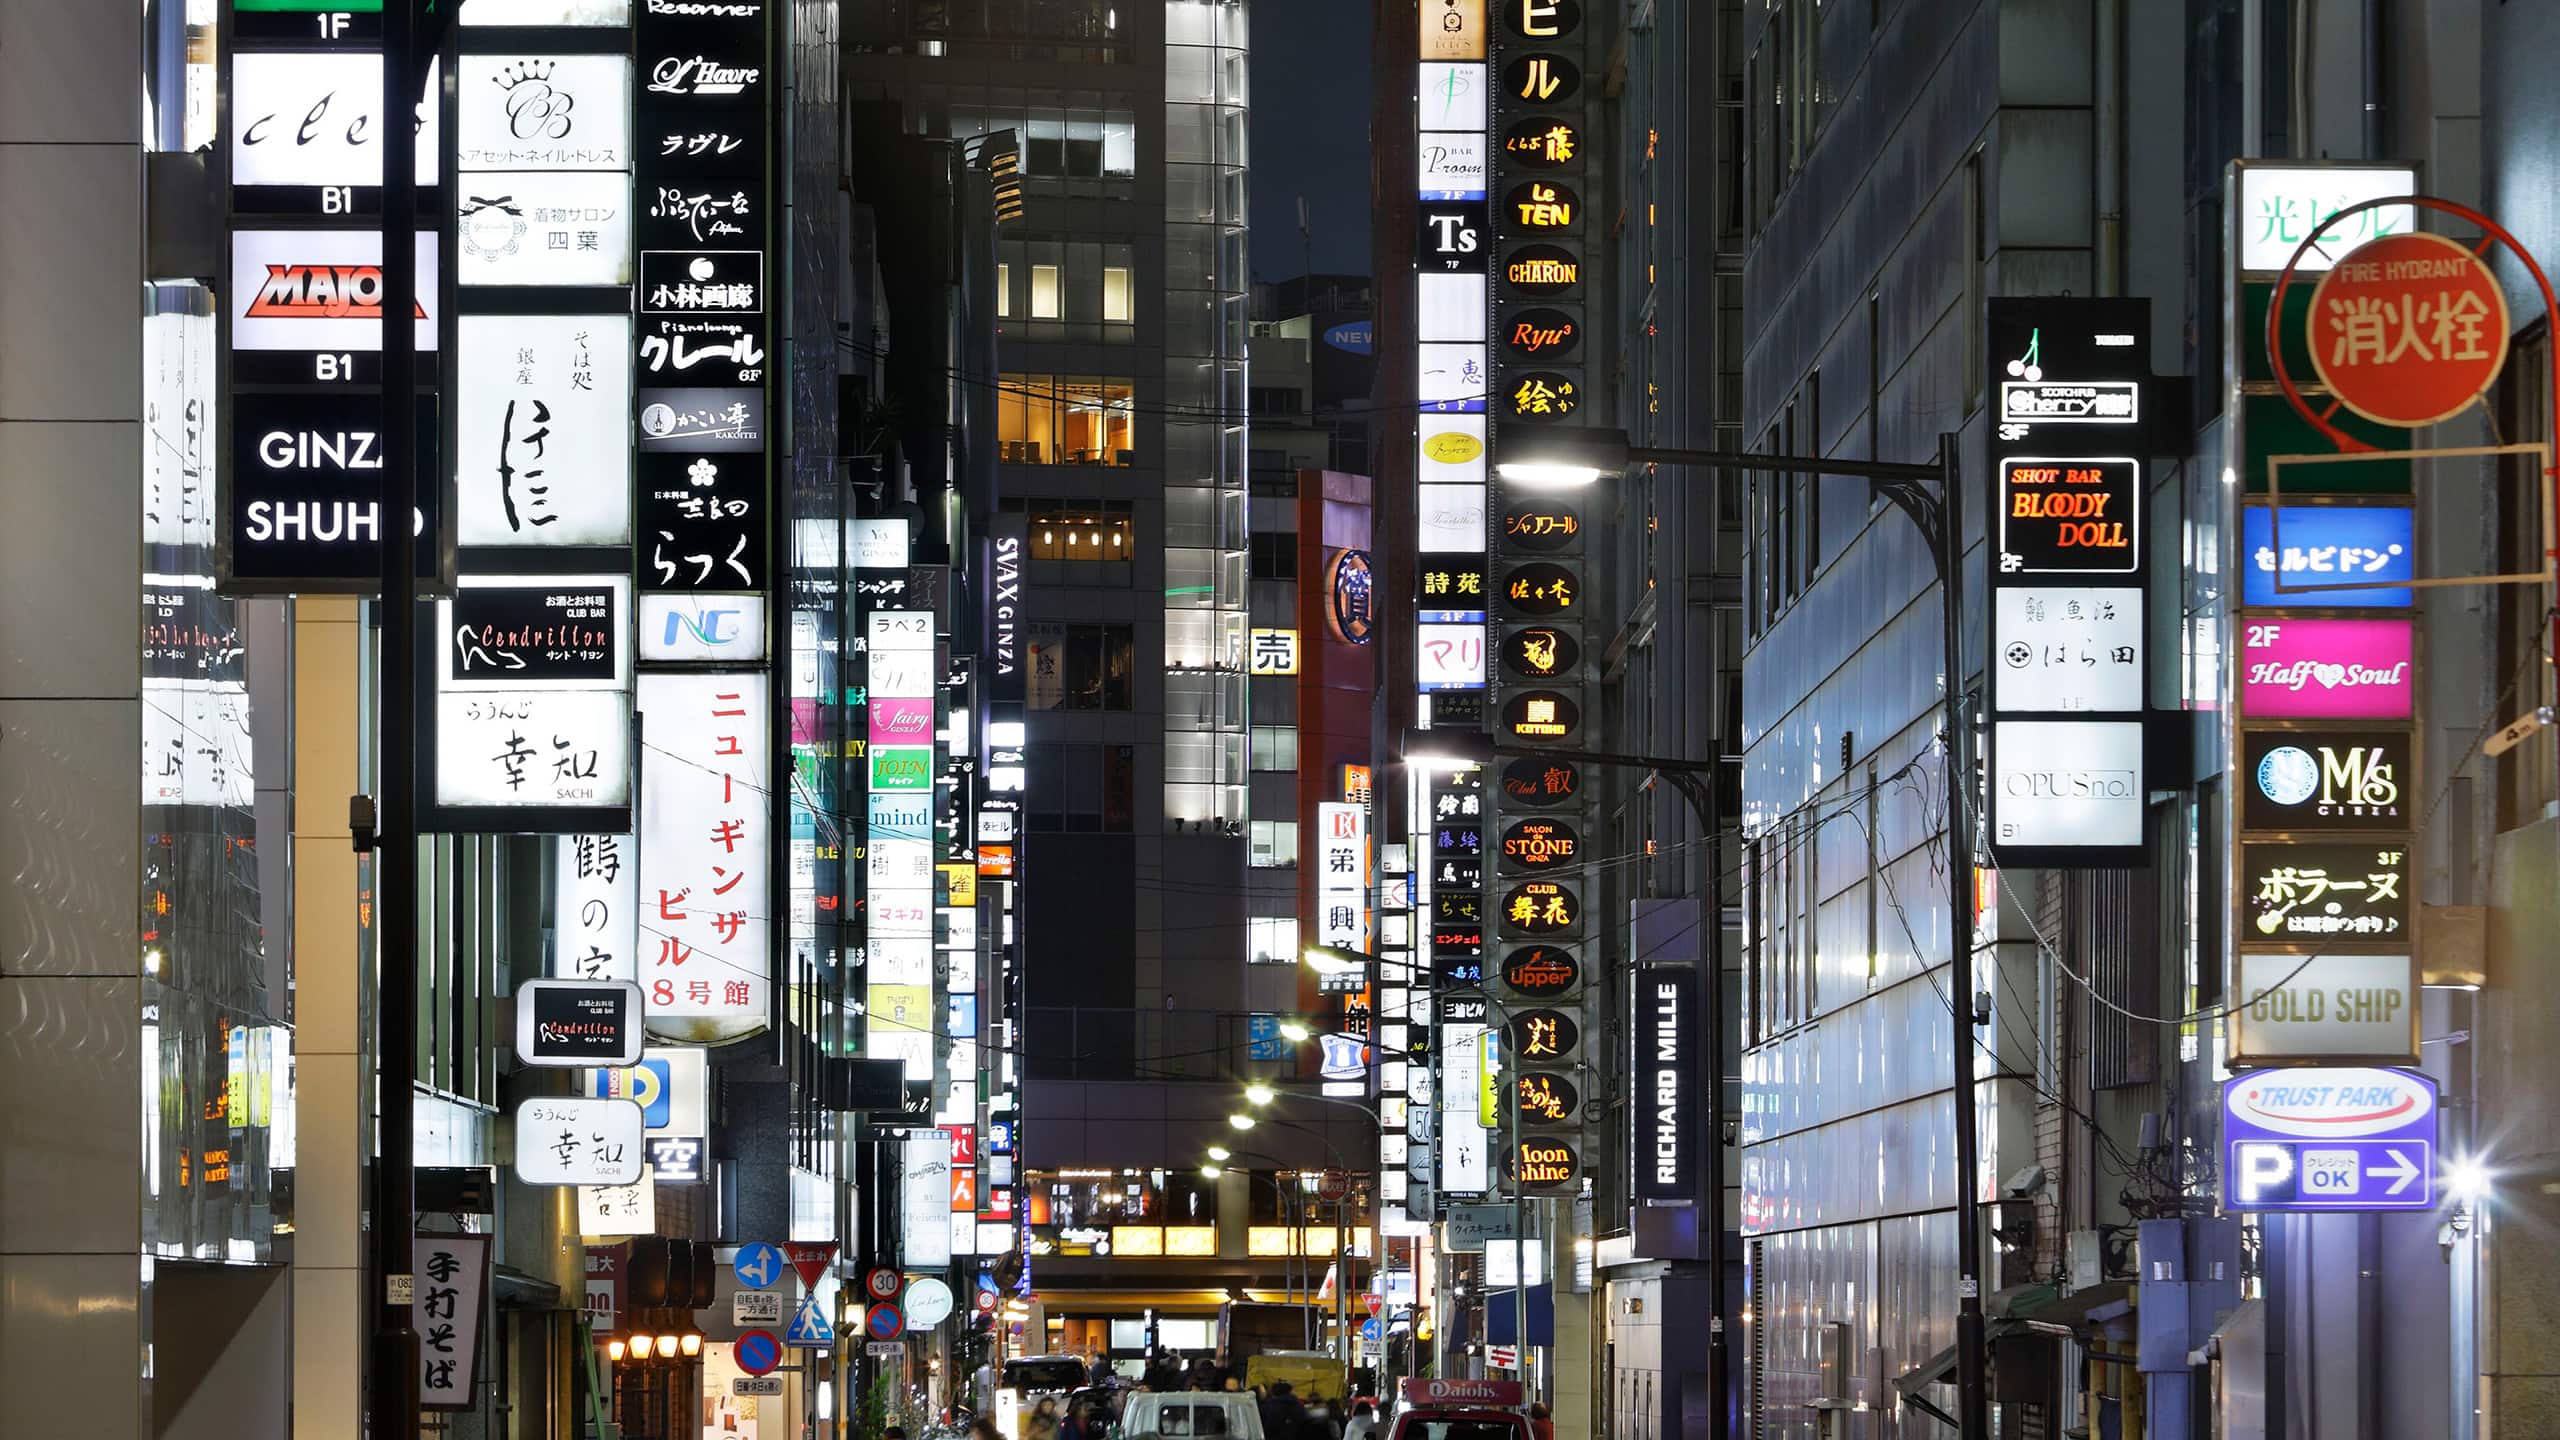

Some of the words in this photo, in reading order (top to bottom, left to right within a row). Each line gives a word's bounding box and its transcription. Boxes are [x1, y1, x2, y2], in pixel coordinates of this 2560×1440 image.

[317, 13, 351, 39] 1F
[661, 134, 743, 155] ラヴレ
[1451, 148, 1473, 156] BAR
[322, 187, 351, 214] B1
[1532, 184, 1556, 202] Le
[1518, 204, 1571, 226] TEN
[549, 231, 598, 251] 四葉
[1429, 215, 1478, 253] Ts
[1446, 260, 1460, 269] 7F
[1508, 264, 1577, 284] CHARON
[2341, 262, 2381, 284] FIRE
[2385, 257, 2469, 281] HYDRANT
[2328, 289, 2490, 367] 消火栓
[640, 334, 764, 372] クレール
[316, 354, 352, 380] B1
[516, 347, 535, 385] 銀座
[738, 369, 762, 381] 6F
[1999, 424, 2030, 441] 3F
[259, 431, 383, 469] GINZ
[2011, 469, 2060, 484] SHOT
[2066, 469, 2103, 484] BAR
[2012, 493, 2111, 518] BLOODY
[2057, 522, 2128, 548] DOLL
[996, 537, 1018, 602] SVAX
[2000, 552, 2024, 573] 2F
[1424, 572, 1481, 594] 詩苑
[1510, 578, 1571, 599] 佐々木
[567, 609, 587, 618] CLUB
[590, 609, 606, 618] BAR
[481, 624, 607, 647] Cendrillon
[998, 606, 1014, 675] GINZA
[2247, 625, 2281, 648] 2F
[1255, 633, 1292, 670] 売
[1424, 637, 1481, 671] マリ
[2247, 660, 2318, 692] Half
[2340, 661, 2409, 686] Soul
[876, 760, 928, 777] JOIN
[556, 788, 594, 800] SACHI
[710, 693, 748, 945] ニューギンザ
[874, 808, 928, 826] mind
[1523, 825, 1553, 834] SALON
[1505, 839, 1574, 855] STONE
[1525, 854, 1550, 863] GINZA
[1526, 884, 1558, 895] CLUB
[880, 908, 924, 921] マキカ
[656, 886, 692, 967] ビル
[652, 978, 750, 1007] 8号館
[2251, 988, 2325, 1023] GOLD
[2335, 988, 2402, 1023] SHIP
[1657, 983, 1678, 1061] MILLE
[2260, 1086, 2333, 1107] TRUST
[2335, 1086, 2399, 1107] PARK
[1656, 1069, 1678, 1184] RICHARD
[654, 1139, 698, 1180] 空
[2305, 1155, 2356, 1168] クレジット
[595, 1167, 622, 1176] SACHI
[2241, 1144, 2293, 1201] P
[2312, 1170, 2350, 1188] OK
[794, 1252, 828, 1263] 止まれ
[875, 1274, 896, 1291] 30
[424, 1251, 460, 1390] 手打そば
[1428, 1380, 1497, 1399] Daiohs
